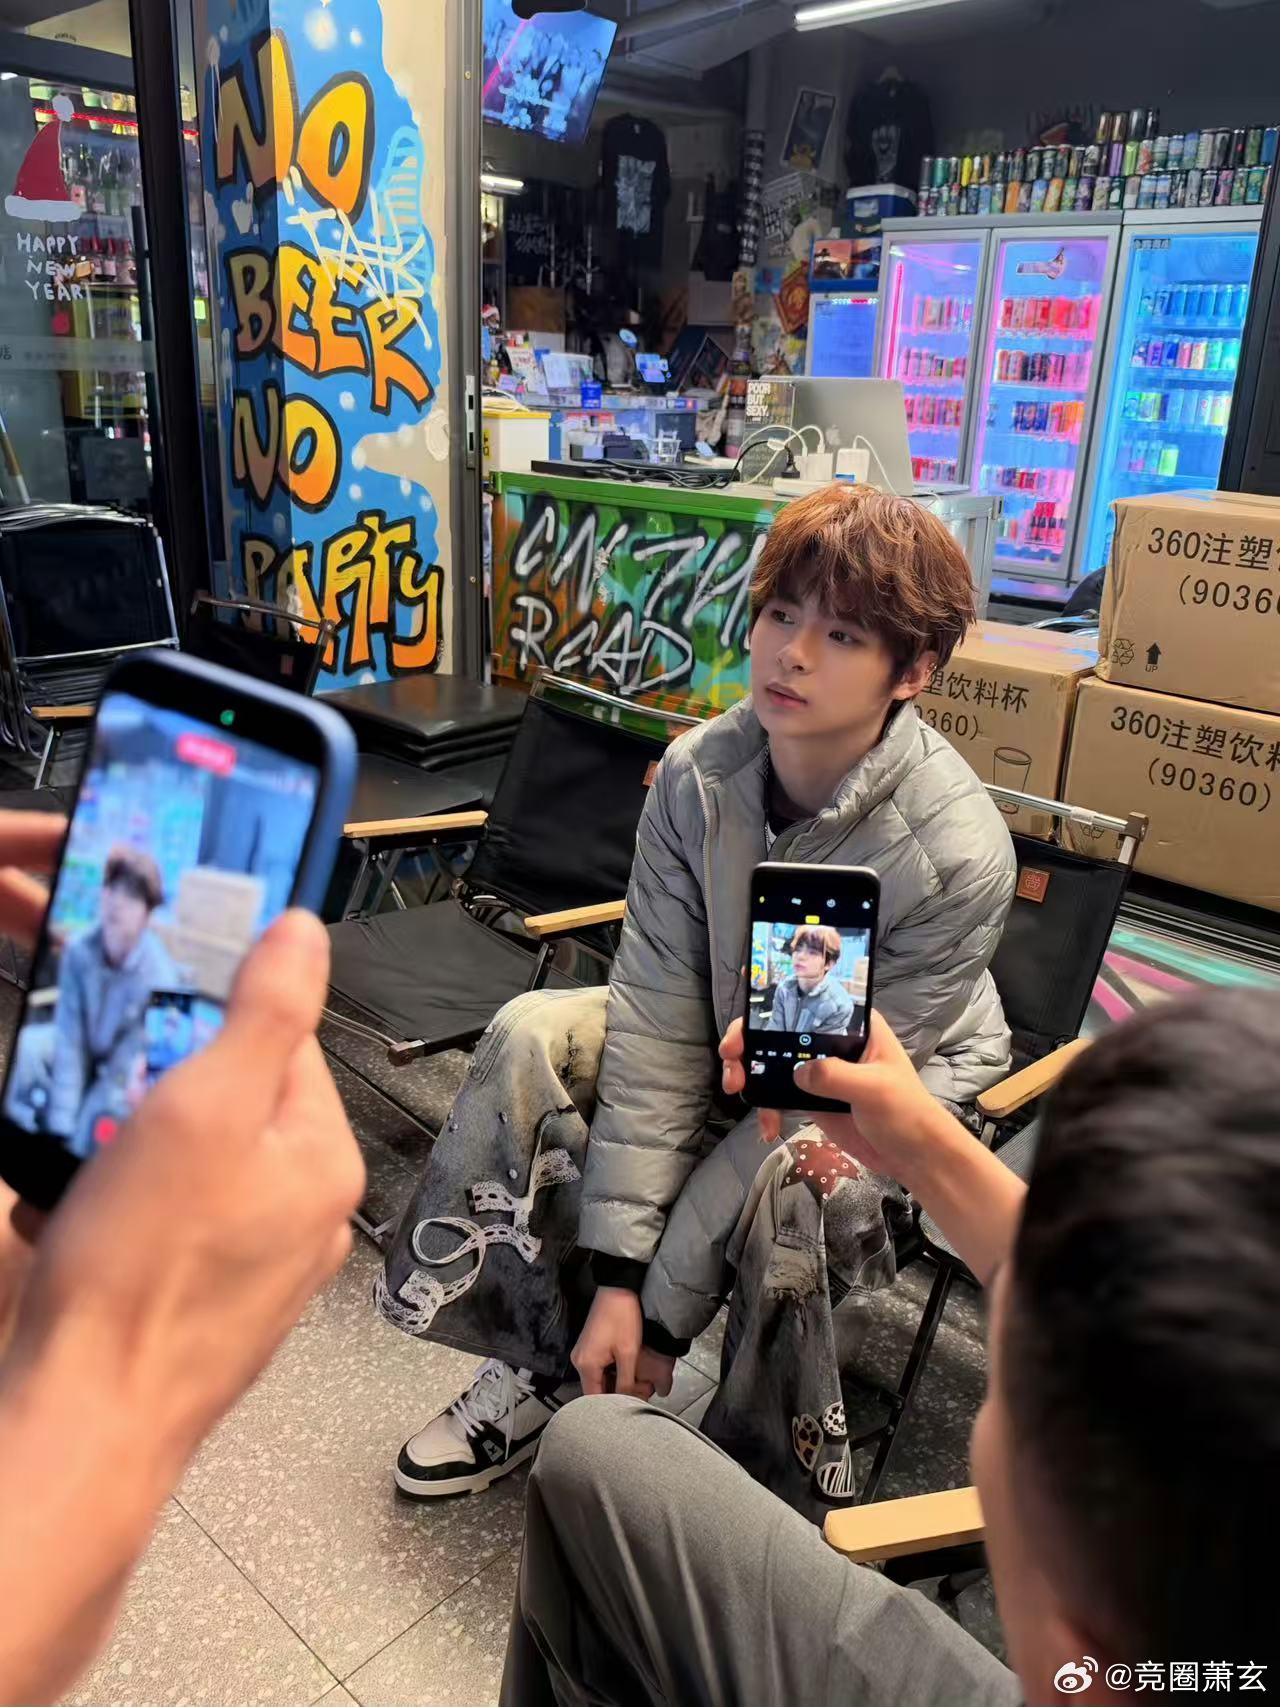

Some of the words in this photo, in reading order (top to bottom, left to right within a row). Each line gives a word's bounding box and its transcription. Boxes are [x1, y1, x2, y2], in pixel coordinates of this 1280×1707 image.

[212, 28, 376, 227] NO
[16, 232, 79, 256] HAPPY
[26, 259, 76, 279] NEW
[25, 280, 83, 301] YEAR
[227, 240, 435, 415] BEER
[746, 394, 764, 405] BUT
[747, 382, 771, 395] POOR
[233, 378, 342, 514] NO
[1147, 527, 1280, 571] 360注塑
[1179, 574, 1280, 615] (9036
[1145, 664, 1159, 673] UP
[1148, 757, 1272, 813] (90360)
